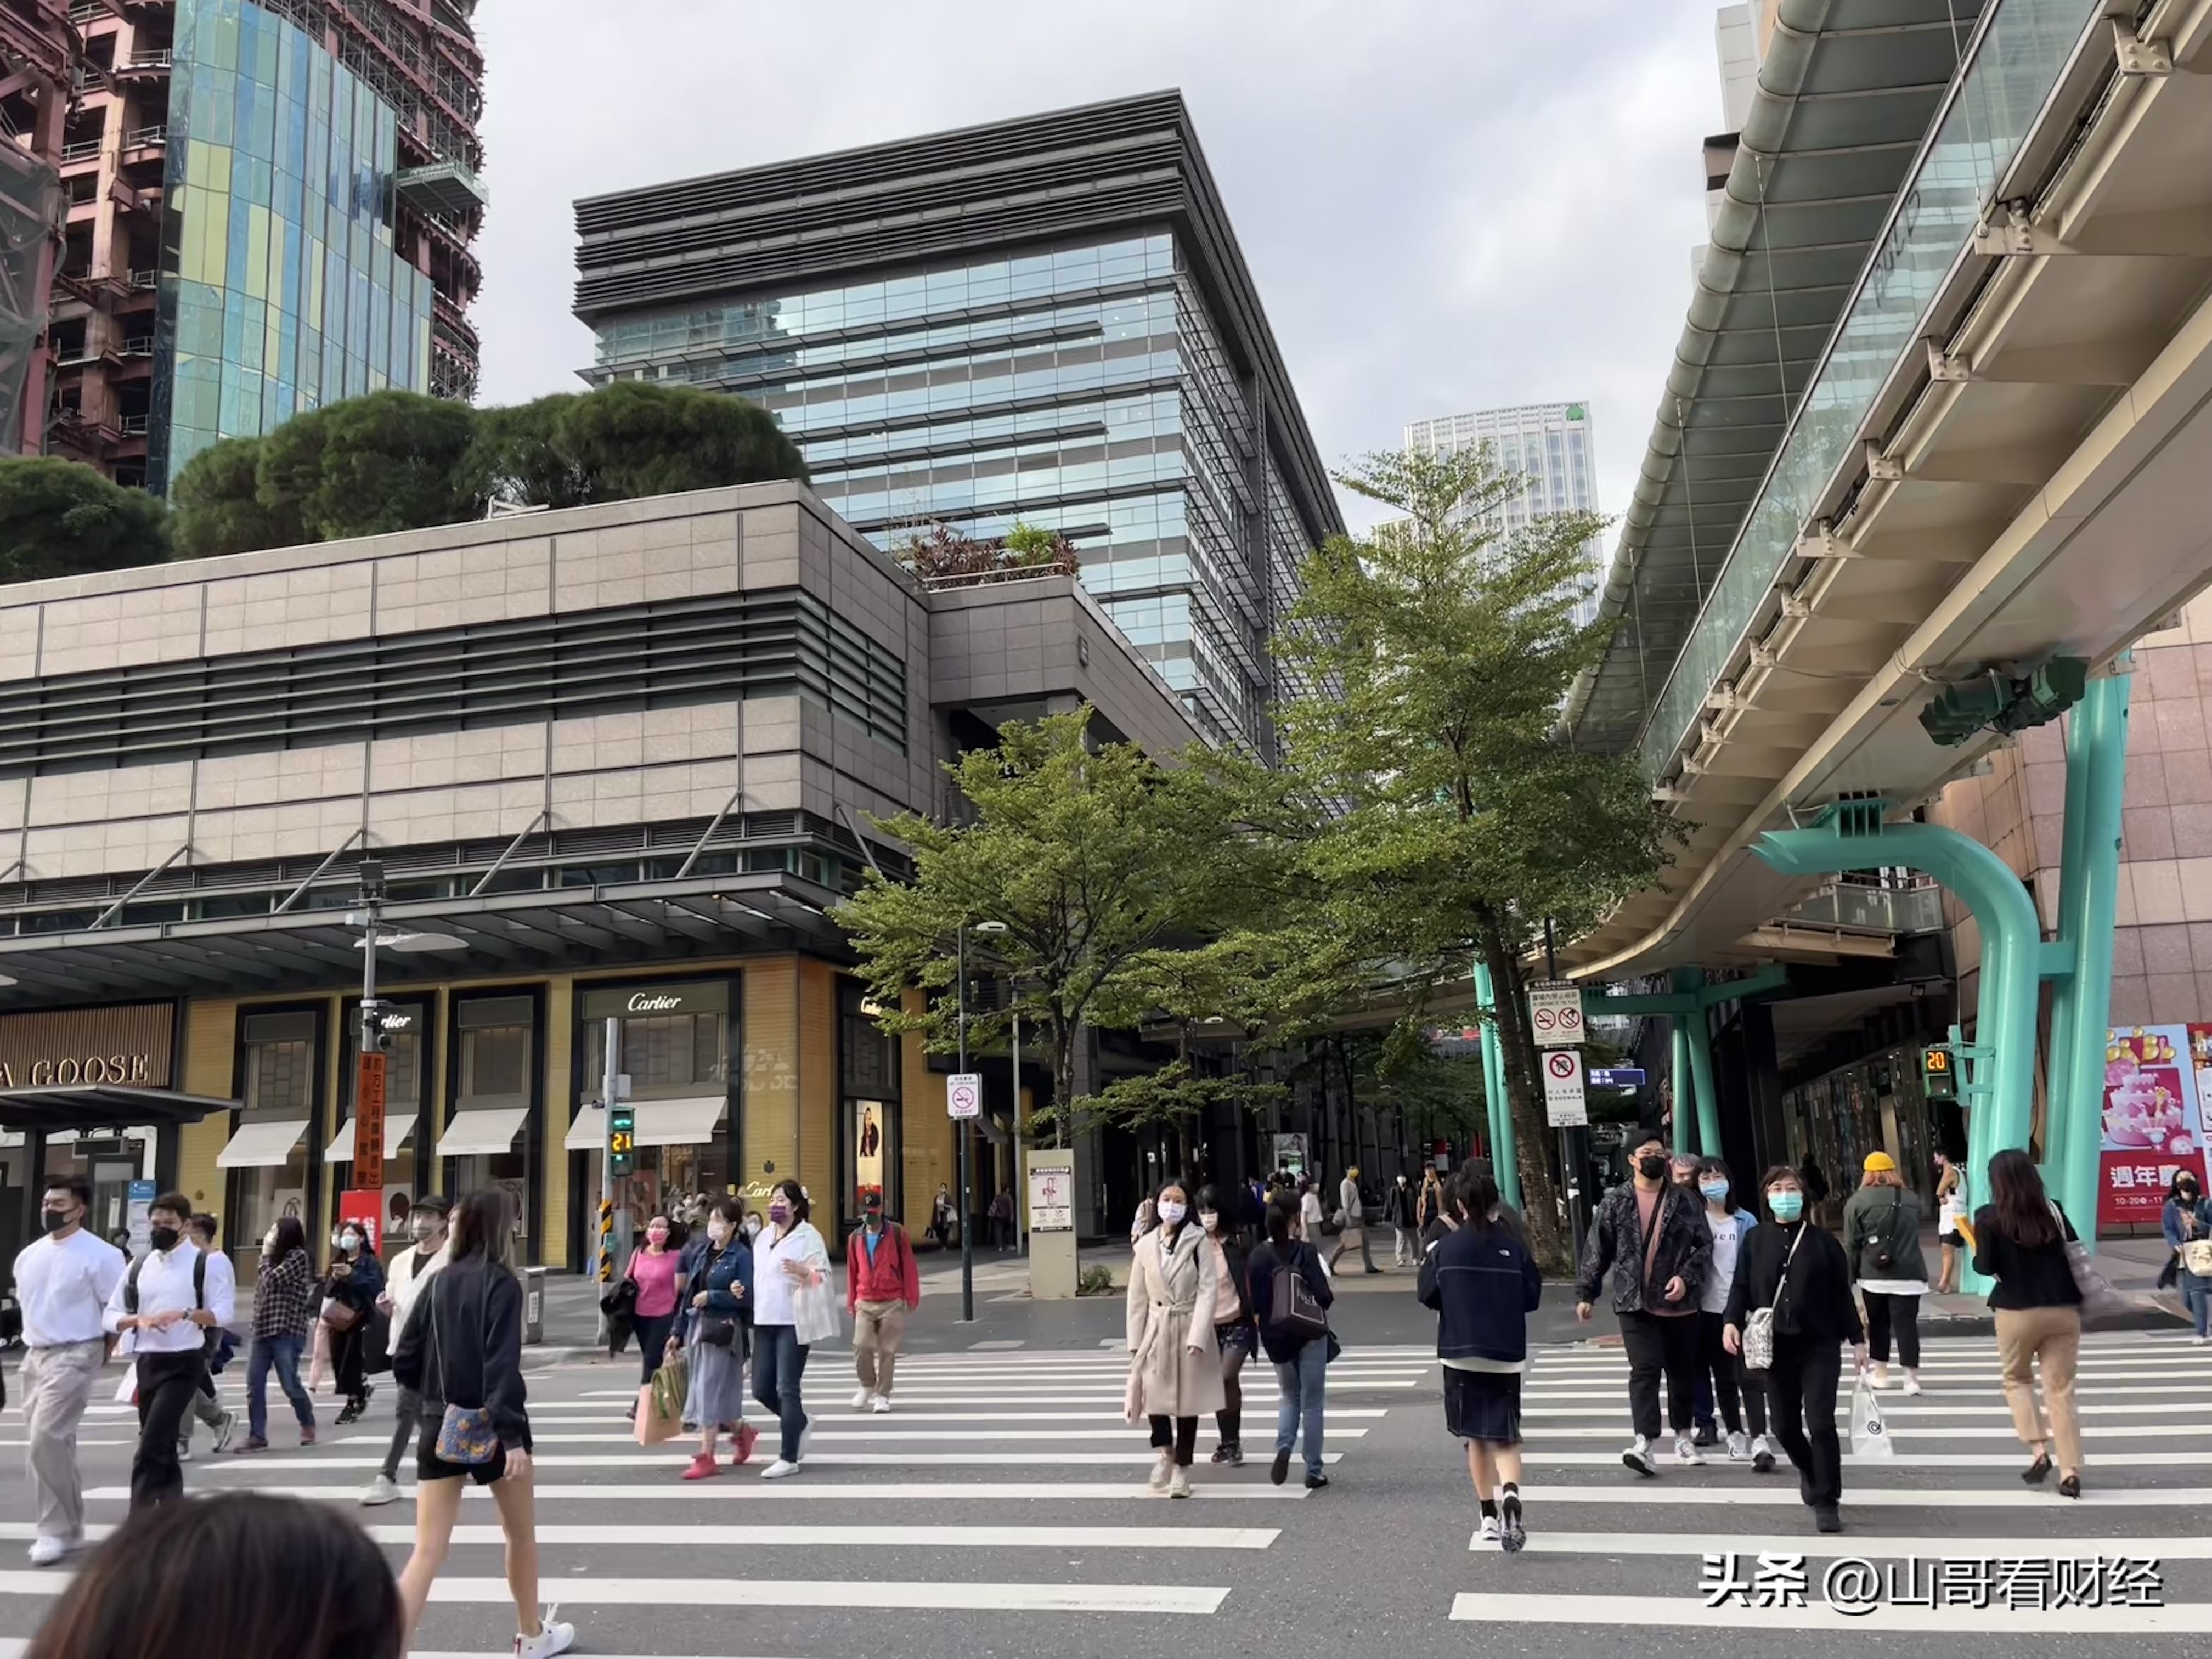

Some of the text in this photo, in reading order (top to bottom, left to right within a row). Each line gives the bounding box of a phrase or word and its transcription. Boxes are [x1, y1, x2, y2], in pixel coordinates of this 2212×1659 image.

[627, 992, 682, 1012] Cartier
[32, 1054, 148, 1086] GOOSE
[1927, 1052, 1945, 1069] 20
[613, 1133, 630, 1151] 21
